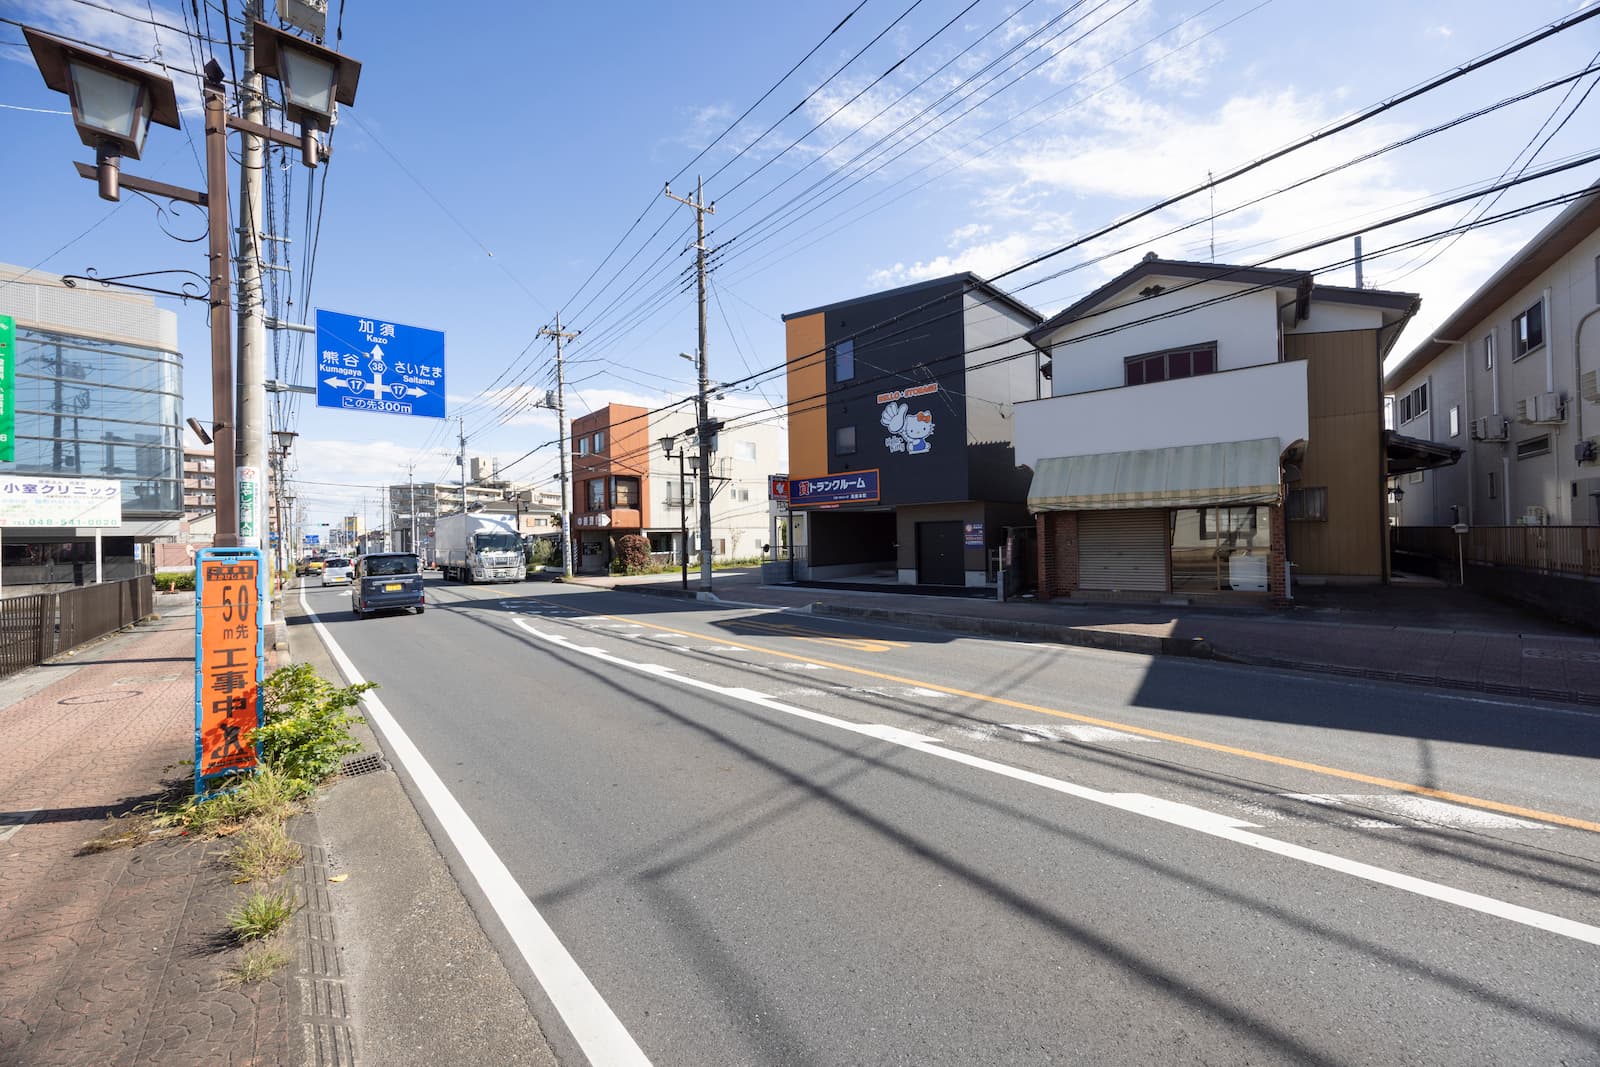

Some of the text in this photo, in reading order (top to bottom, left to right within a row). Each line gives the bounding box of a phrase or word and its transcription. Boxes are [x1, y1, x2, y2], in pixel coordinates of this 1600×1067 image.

[358, 319, 395, 338] 加須
[366, 334, 388, 345] Kazo
[322, 350, 360, 368] 熊谷
[319, 363, 362, 377] Kumagaya
[372, 362, 384, 372] 38
[394, 361, 443, 379] さいたま
[350, 379, 361, 390] 17
[402, 375, 436, 386] Saitama
[394, 385, 404, 395] 17
[344, 398, 411, 413] この先300m
[3, 482, 118, 496] 小室クリニック
[222, 584, 249, 623] 50
[223, 623, 249, 640] m先
[211, 647, 248, 719] 工事中
